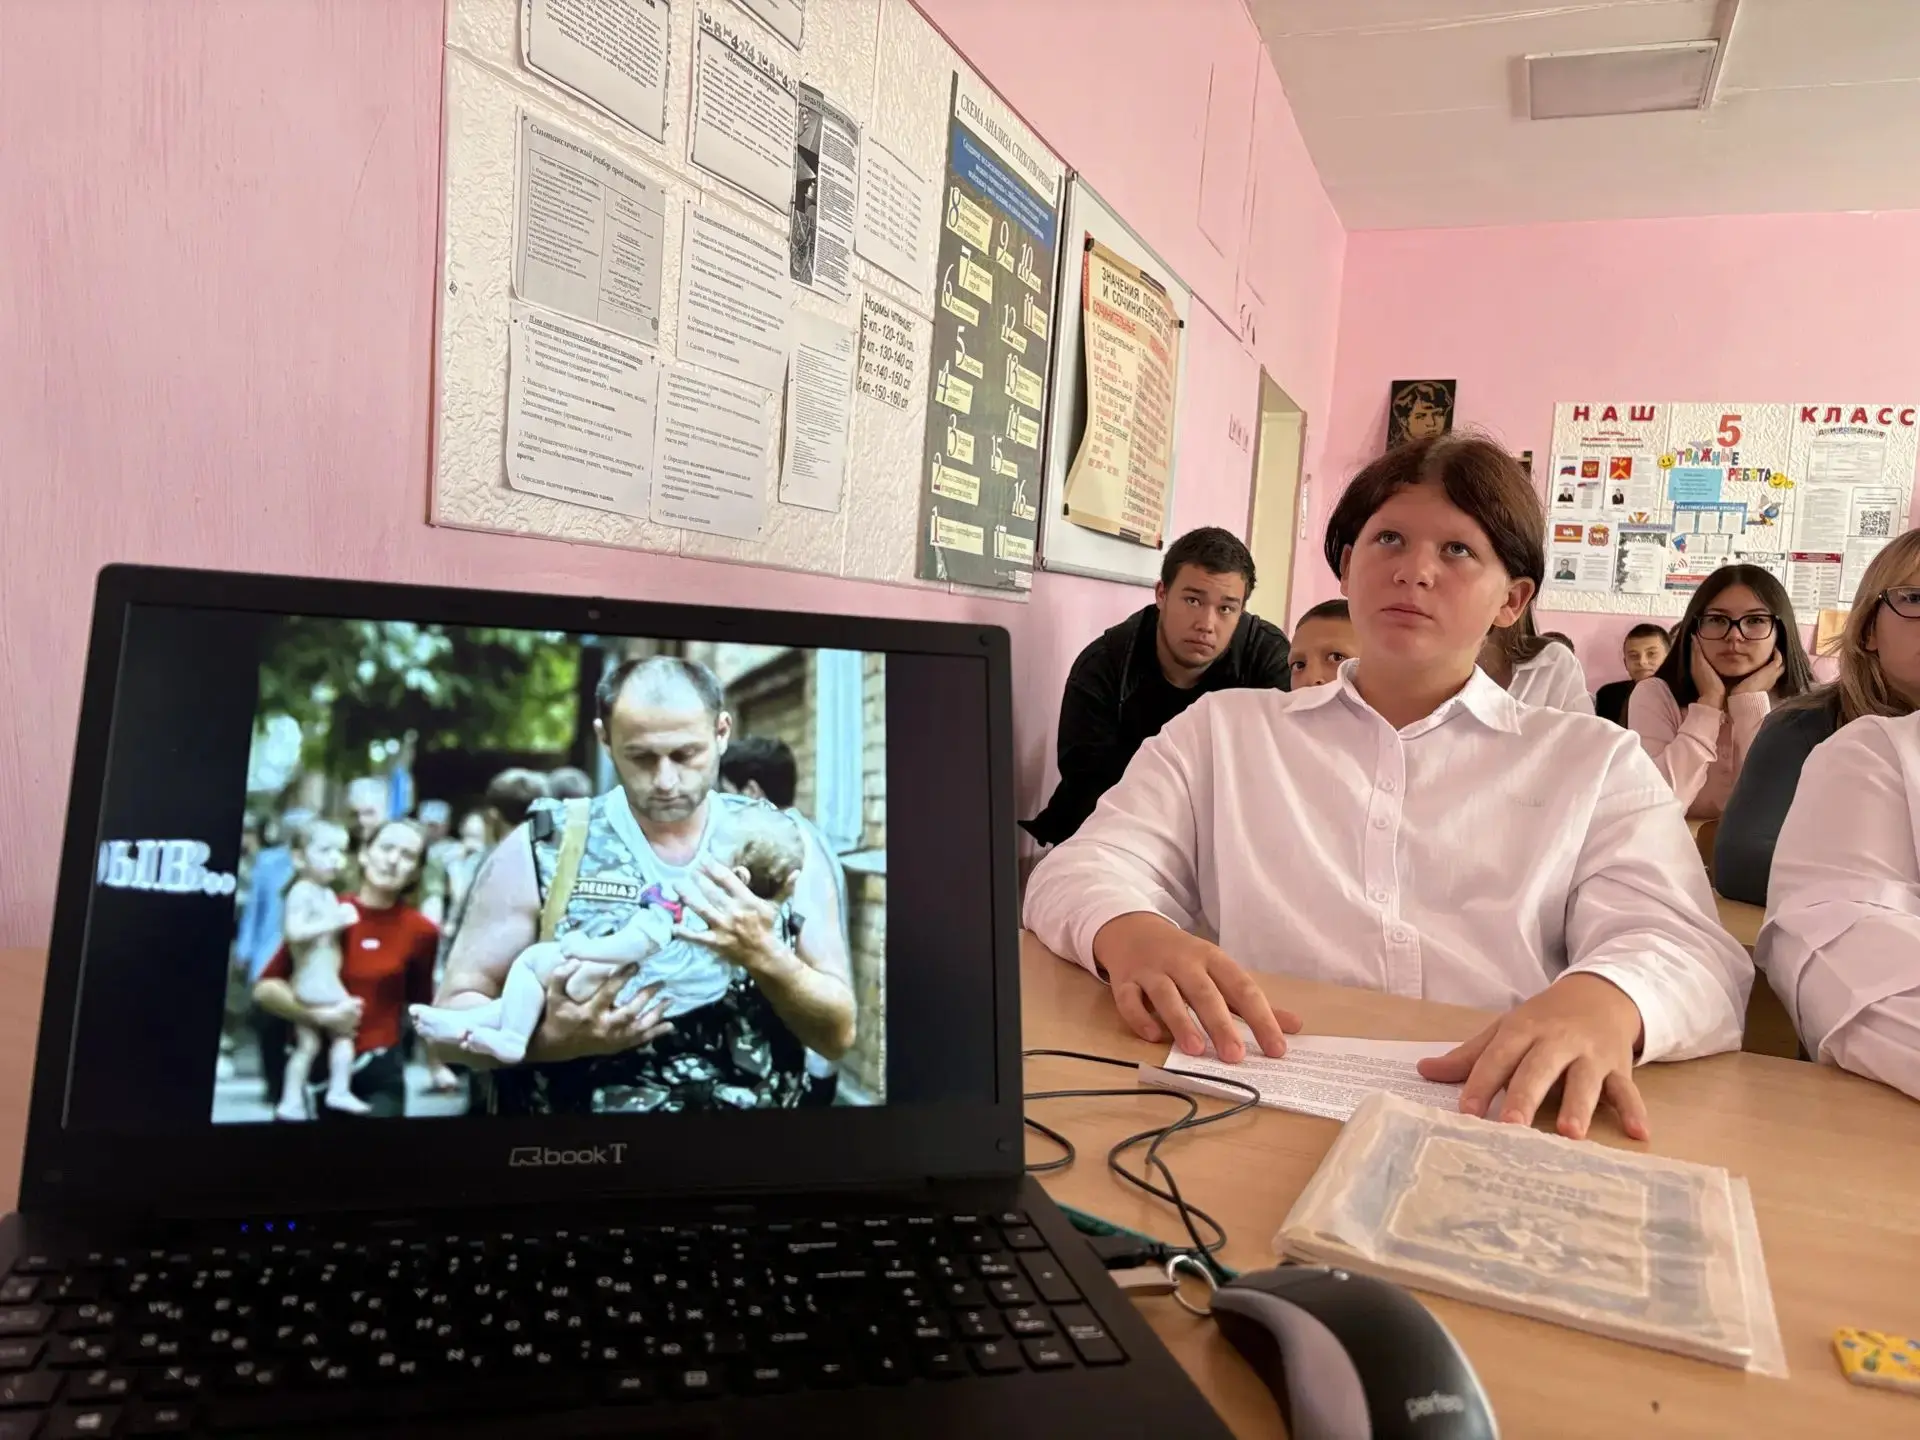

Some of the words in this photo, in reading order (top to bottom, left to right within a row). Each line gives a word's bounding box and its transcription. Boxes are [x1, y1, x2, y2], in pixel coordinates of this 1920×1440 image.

[530, 124, 593, 159] Синтаксический
[593, 154, 611, 171] разбор
[961, 94, 984, 127] СХЕМА
[985, 117, 1011, 152] АНАЛИЗА
[1012, 142, 1055, 195] СТИХОТВОРЕНИЯ
[949, 187, 961, 228] 8
[997, 221, 1009, 261] 9
[961, 245, 972, 288] 7
[1019, 243, 1033, 281] 10
[943, 264, 954, 307] 6
[1102, 267, 1139, 301] ЗНАЧЕНИЯ
[1103, 286, 1108, 299] И
[863, 315, 868, 328] 5
[864, 293, 890, 317] Нормы
[1001, 304, 1016, 343] 12
[1024, 292, 1033, 329] 11
[880, 344, 905, 367] 130-140
[956, 325, 965, 366] 5
[939, 360, 950, 402] 4
[1007, 353, 1018, 395] 13
[948, 413, 957, 457] 3
[1573, 405, 1655, 421] НАШ
[1801, 406, 1916, 426] КЛАСС
[1717, 414, 1742, 447] 5
[933, 452, 942, 491] 2
[991, 434, 1003, 474] 15
[1727, 468, 1771, 482] РЕБЯТА
[1013, 480, 1027, 516] 16
[931, 505, 940, 543] 1
